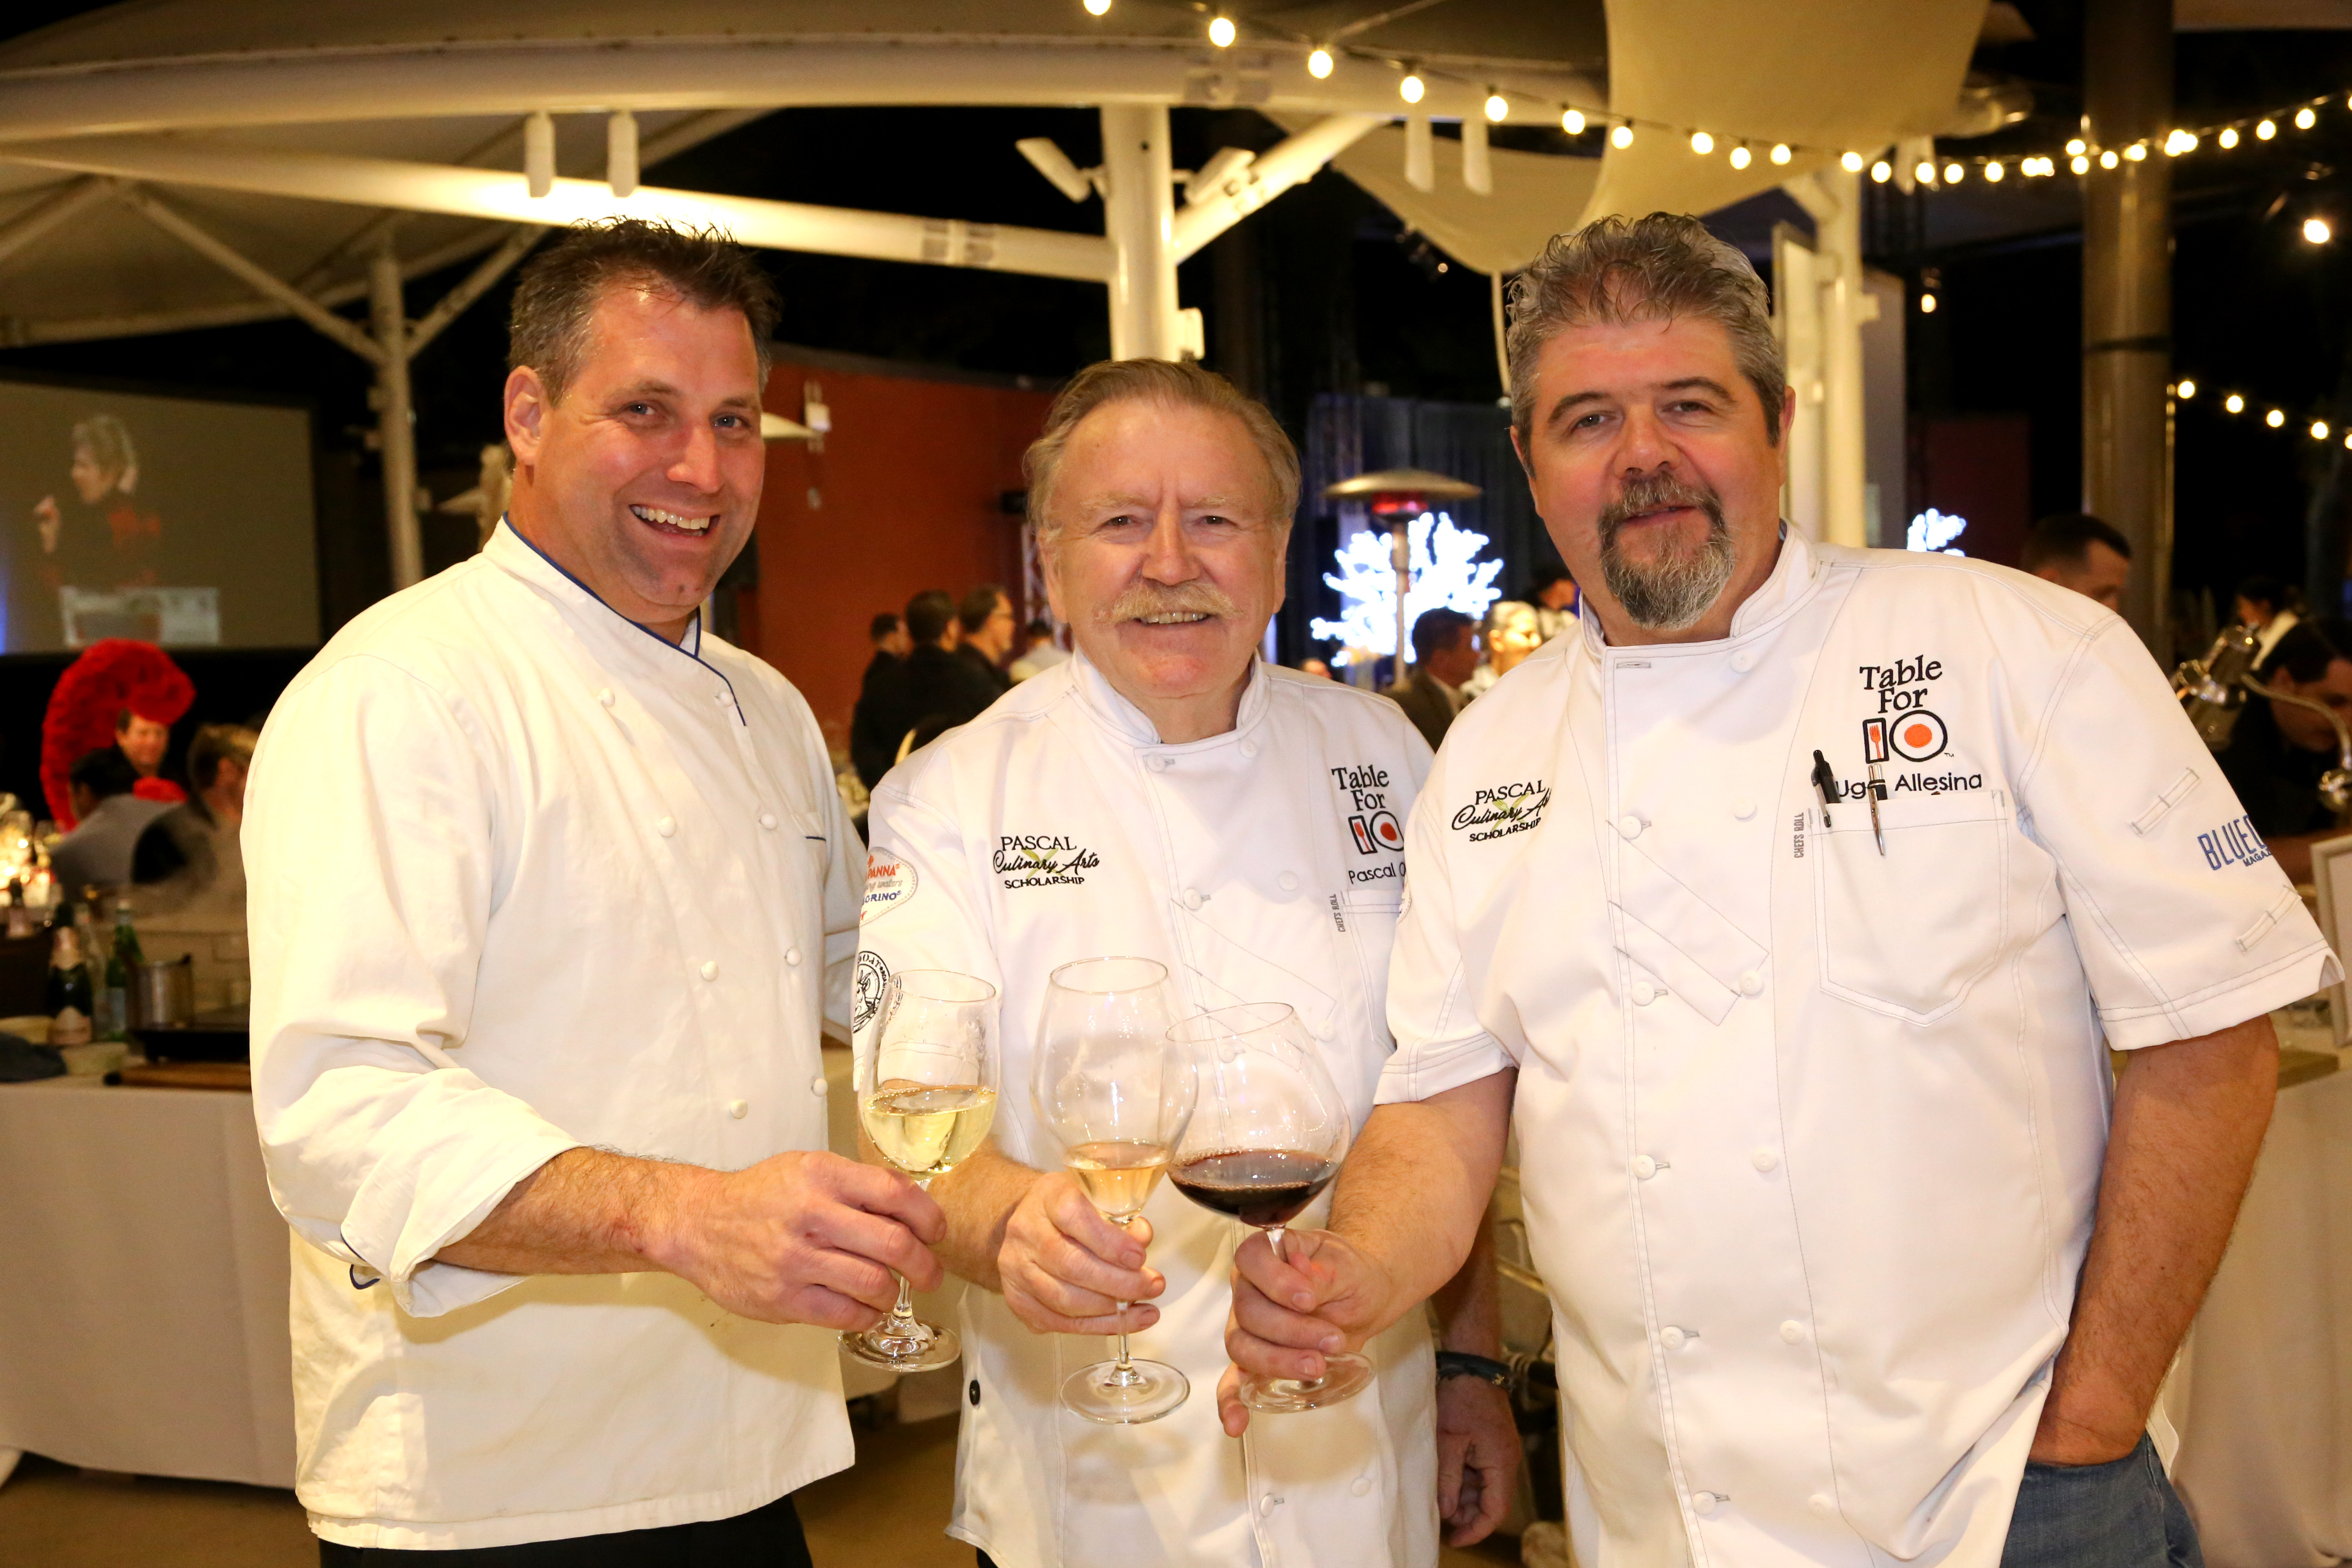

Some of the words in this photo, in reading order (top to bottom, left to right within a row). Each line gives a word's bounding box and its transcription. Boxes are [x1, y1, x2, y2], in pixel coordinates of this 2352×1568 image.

[1859, 655, 1942, 690] Table
[1878, 688, 1928, 714] For
[1331, 765, 1389, 790] Table
[1835, 779, 1867, 799] Ug
[1894, 772, 1982, 791] Allesina
[1351, 789, 1386, 811] For
[1475, 779, 1546, 805] PASCAL
[1452, 805, 1522, 830] Culinary
[1469, 817, 1541, 842] SCHOLARSHIP
[1794, 812, 1804, 831] ROLL
[1000, 836, 1077, 851] PASCAL
[1794, 834, 1804, 858] CHEFS
[993, 850, 1058, 874] Culinary
[1056, 848, 1100, 876] Arts
[1348, 862, 1396, 885] Pascal
[1004, 876, 1085, 889] SCHOLARSHIP
